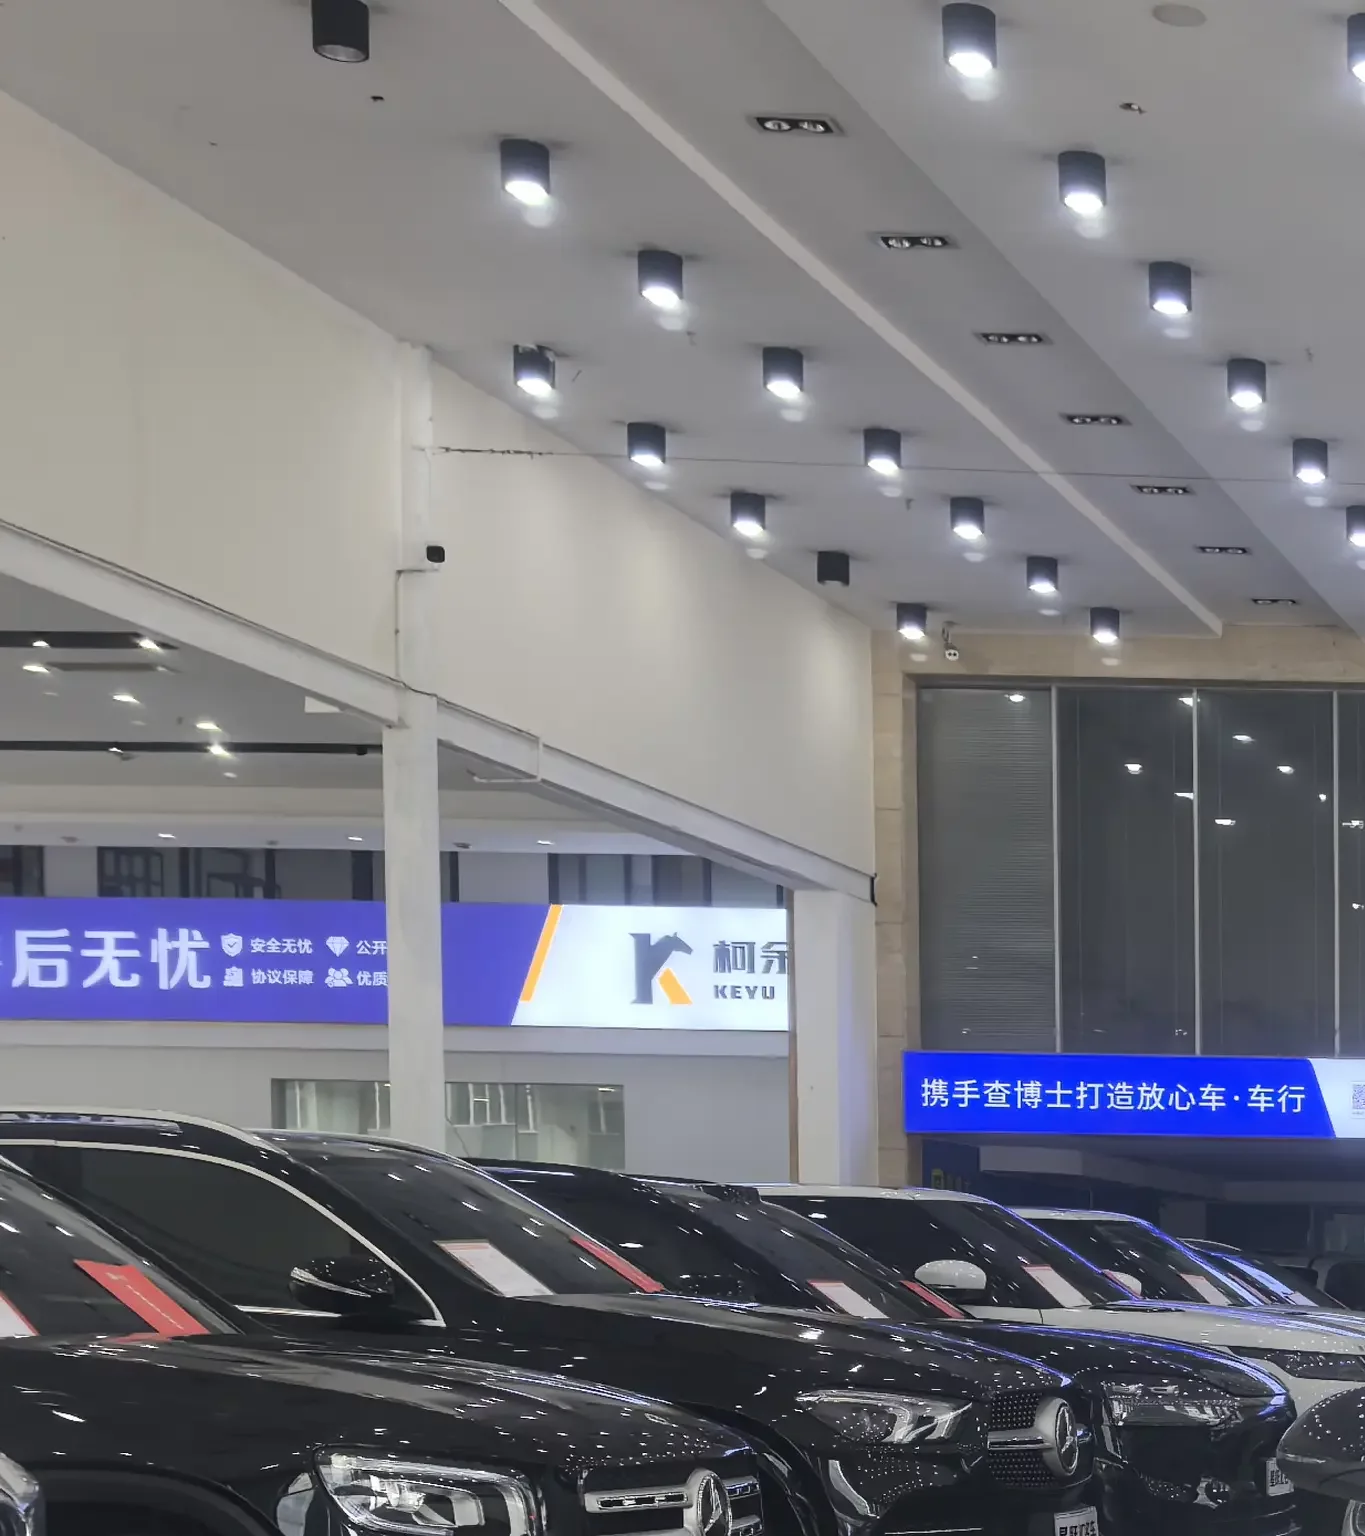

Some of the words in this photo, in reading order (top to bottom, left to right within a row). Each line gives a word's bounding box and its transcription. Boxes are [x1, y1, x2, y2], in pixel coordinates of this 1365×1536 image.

[250, 937, 313, 954] 安全无忧
[356, 939, 388, 955] 公开
[0, 928, 211, 990] 后无忧
[251, 968, 315, 985] 协议保障
[356, 971, 388, 987] 优质
[713, 985, 775, 1000] KEYU
[920, 1076, 1306, 1114] 携手查博士打造放心车·车行
